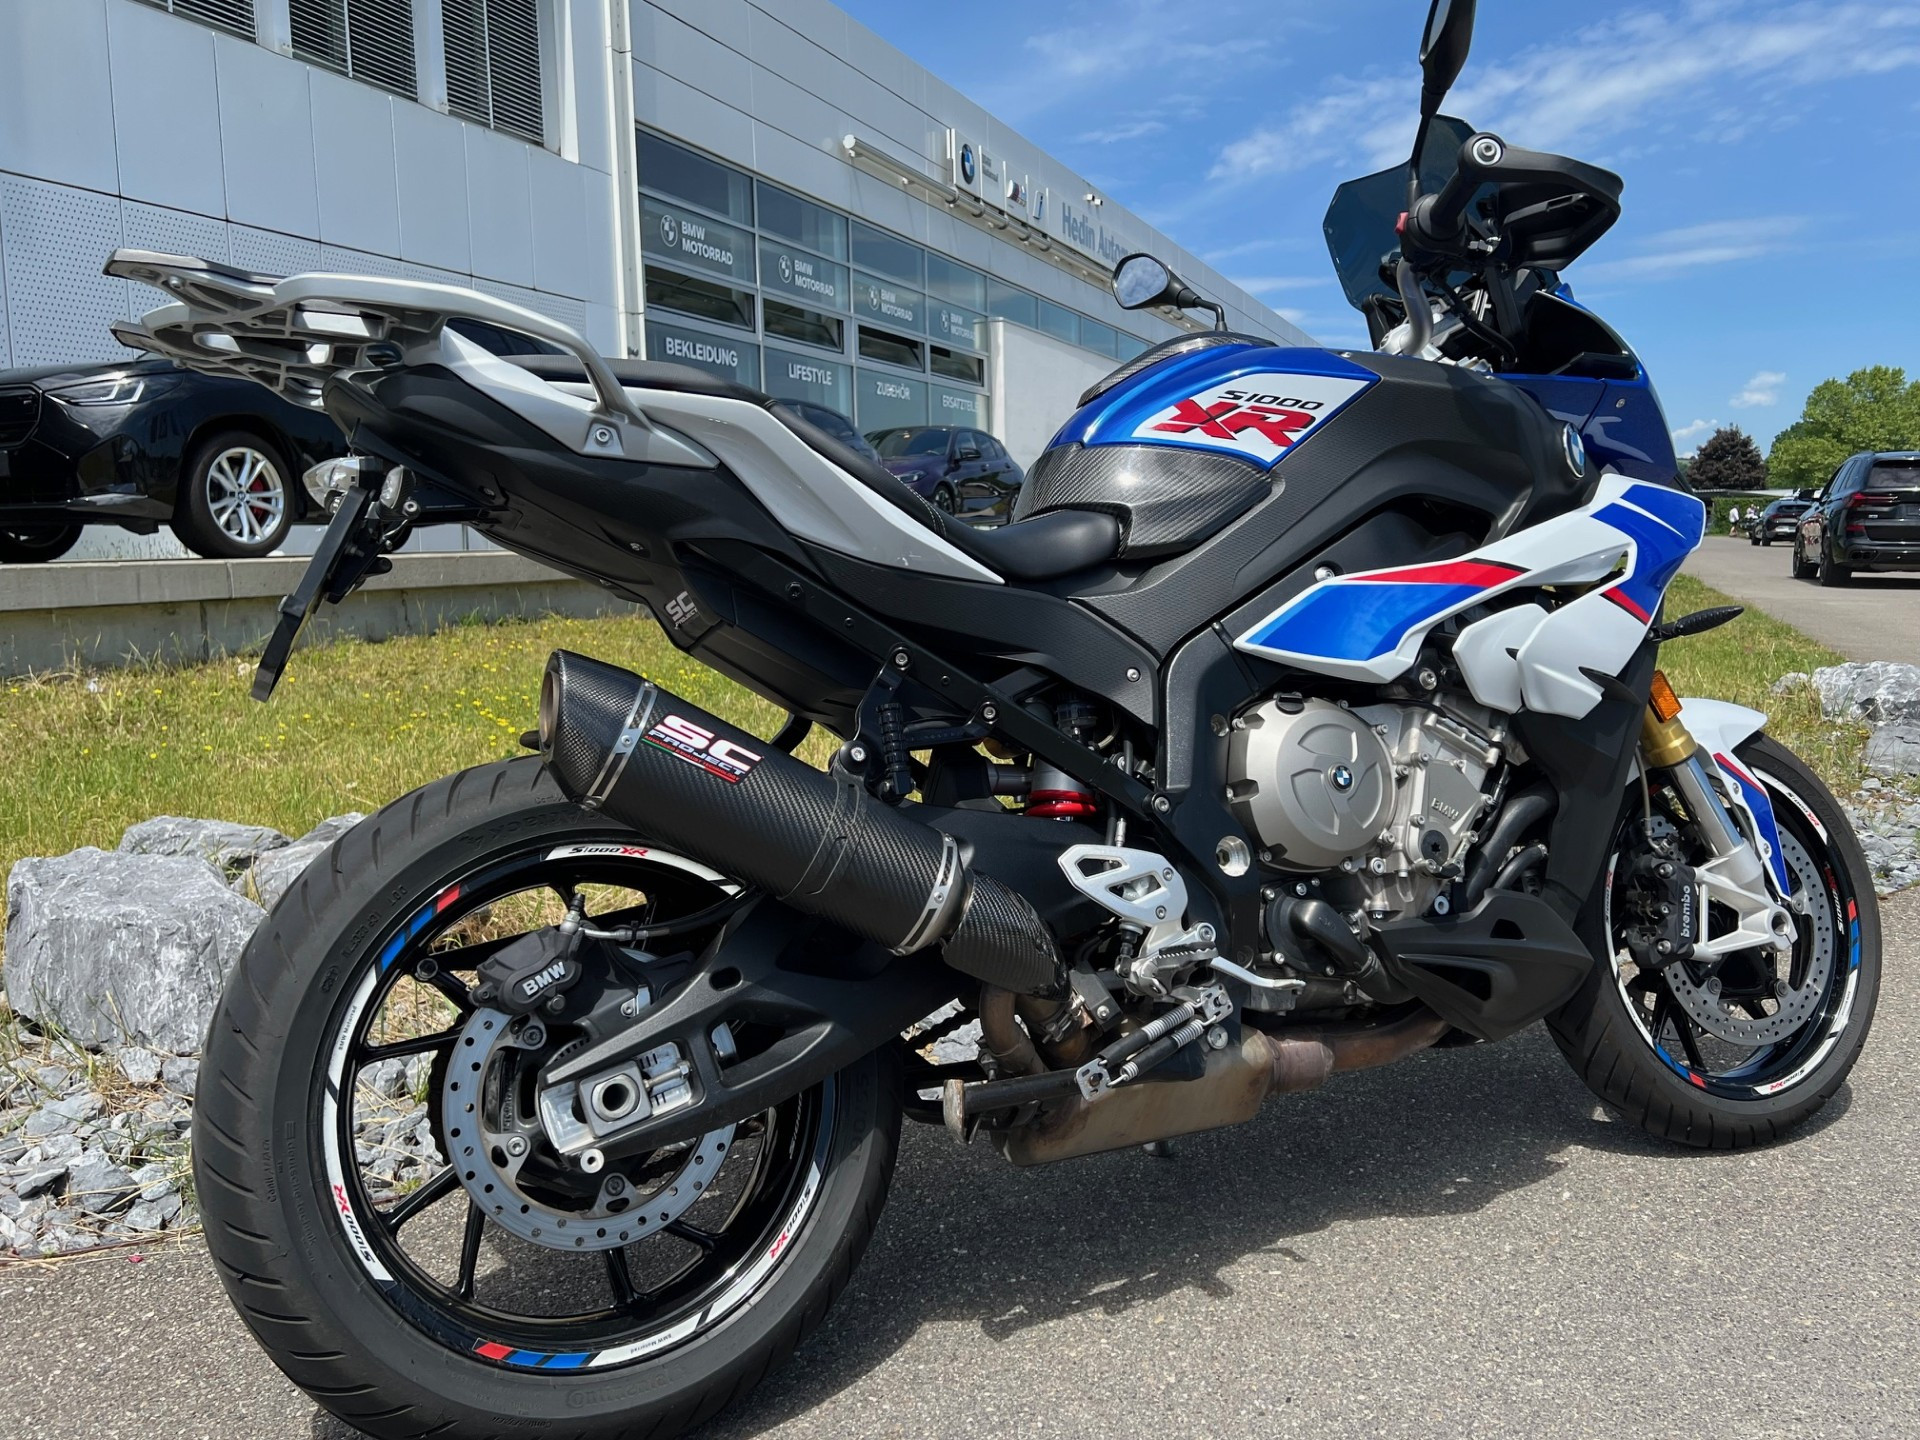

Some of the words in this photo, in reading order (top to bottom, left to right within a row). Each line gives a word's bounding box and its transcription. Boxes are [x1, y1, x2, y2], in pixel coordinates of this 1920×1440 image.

[681, 221, 706, 241] BMW
[1062, 201, 1095, 251] Hedin
[1098, 225, 1139, 264] Autom
[681, 238, 733, 265] MOTORRAD
[794, 259, 814, 276] BMW
[794, 274, 834, 297] MOTORRAD
[880, 289, 896, 302] BMW
[881, 302, 913, 322] MOTORRAD
[666, 337, 738, 367] BEKLEIDUNG
[788, 362, 833, 386] LIFESTYLE
[875, 381, 911, 400] ZUBEHÖR
[1217, 389, 1325, 411] S1000
[1150, 398, 1316, 447] XR
[665, 590, 695, 622] SC
[647, 729, 747, 776] PROJECT
[654, 714, 764, 772] SC
[1431, 797, 1460, 821] BMW
[568, 846, 649, 857] S1000XR
[1681, 885, 1691, 938] brembo
[522, 961, 566, 996] BMW
[333, 1184, 376, 1263] S1000XR
[769, 1183, 811, 1259] S1000XR
